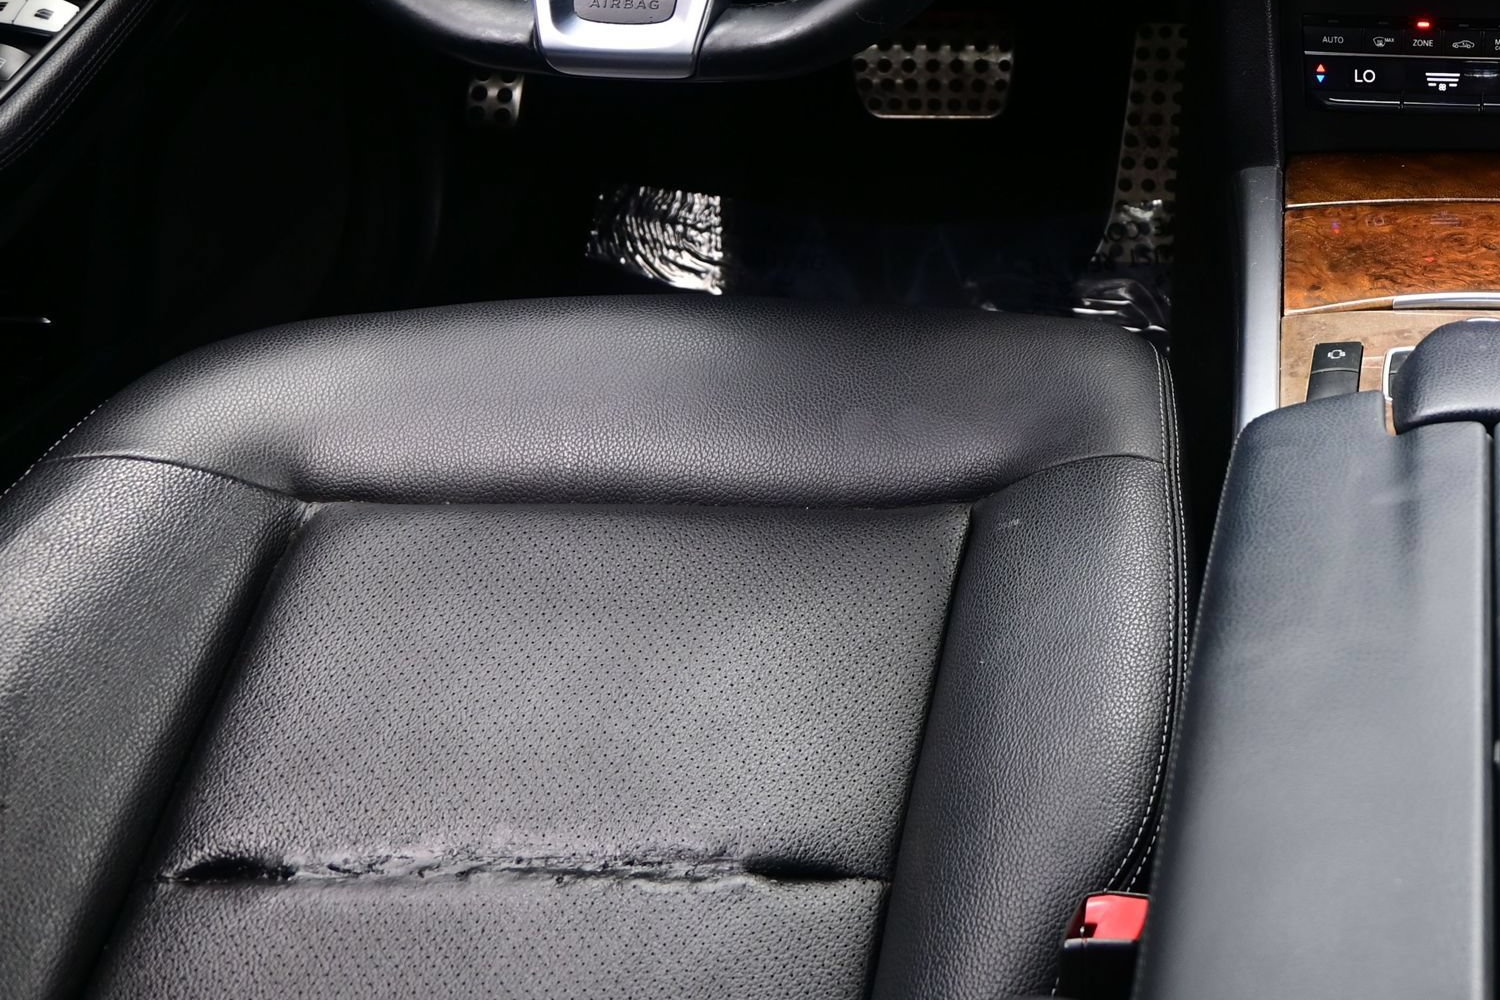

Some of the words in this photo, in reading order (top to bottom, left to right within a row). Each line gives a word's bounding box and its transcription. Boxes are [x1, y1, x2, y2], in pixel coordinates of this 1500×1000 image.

[1322, 36, 1344, 44] AUTO
[1412, 39, 1434, 47] ZONE
[1354, 69, 1376, 83] LO
